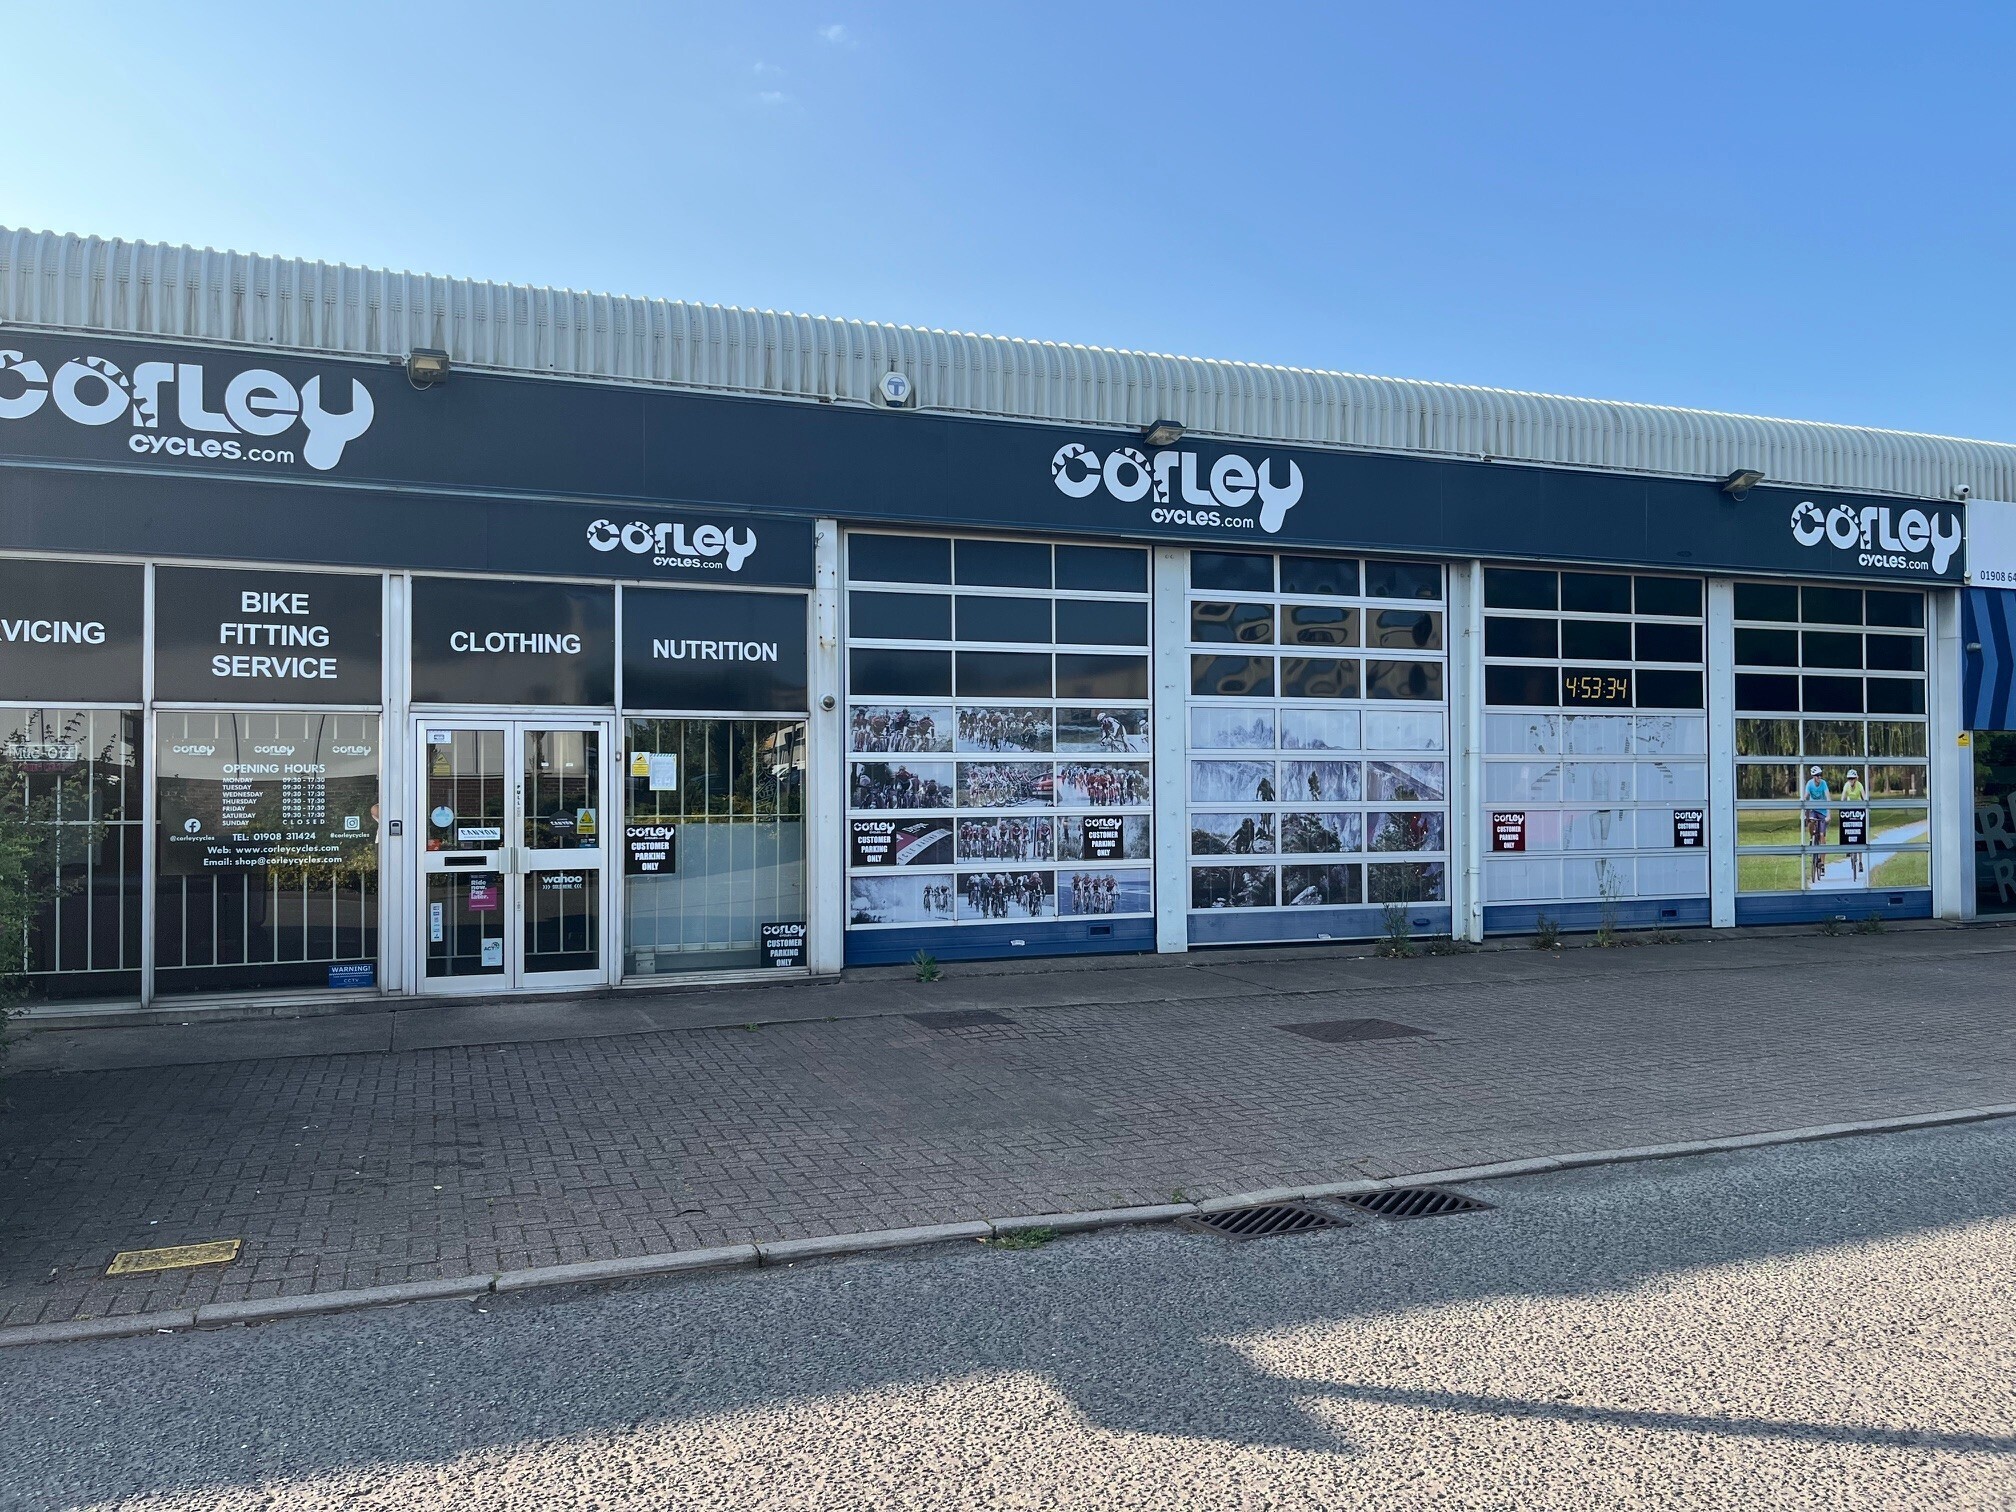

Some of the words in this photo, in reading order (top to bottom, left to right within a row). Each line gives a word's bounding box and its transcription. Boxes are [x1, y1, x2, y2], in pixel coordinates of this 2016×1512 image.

[1980, 570, 2006, 582] 01908
[241, 591, 310, 615] BIKE
[0, 619, 106, 644] VICING
[220, 622, 330, 647] FITTING
[450, 631, 581, 655] CLOTHING
[653, 638, 778, 662] NUTRITION
[212, 655, 338, 679] SERVICE
[1566, 677, 1627, 699] 4:53:34
[223, 764, 279, 773] OPENING
[284, 764, 326, 773] HOURS
[233, 833, 249, 841] TEL:
[253, 833, 282, 841] 01908
[286, 832, 316, 840] 311424
[857, 836, 891, 844] CUSTOMER
[207, 846, 232, 854] Web:
[236, 844, 339, 855] www.corleycycles.com
[631, 842, 669, 850] CUSTOMER
[861, 845, 888, 853] PARKING
[203, 858, 232, 866] Email:
[235, 856, 342, 867] shop@corleycycles.com
[635, 852, 666, 860] PARKING
[642, 862, 659, 871] ONLY
[542, 873, 582, 884] wahoo
[767, 939, 802, 947] CUSTOMER
[770, 949, 798, 957] PARKING
[331, 965, 371, 973] WARNING!
